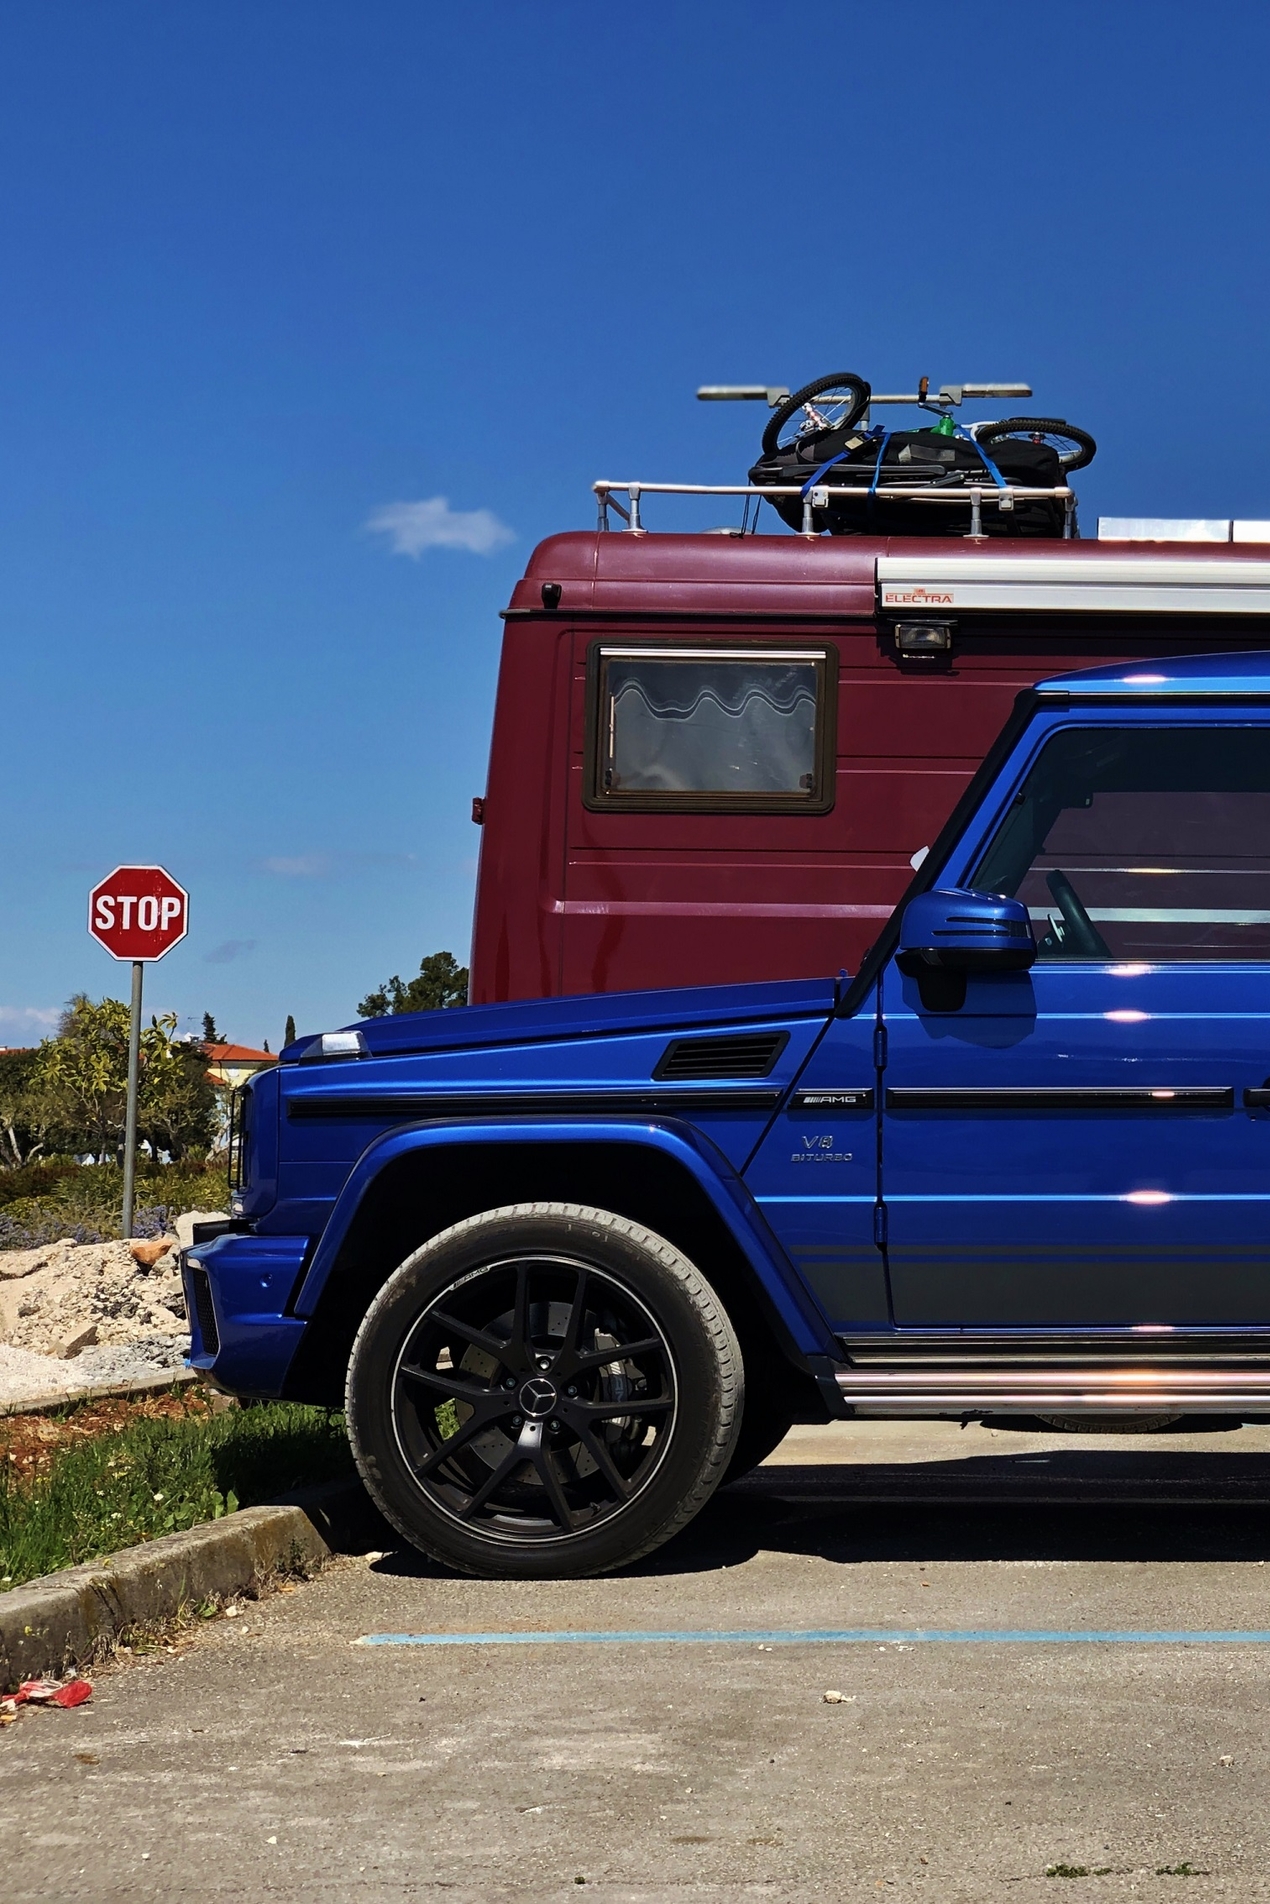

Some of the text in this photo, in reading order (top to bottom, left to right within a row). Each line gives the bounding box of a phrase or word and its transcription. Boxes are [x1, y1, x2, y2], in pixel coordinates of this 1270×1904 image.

[885, 594, 953, 604] ELECTRA
[95, 895, 181, 931] STOP
[802, 1135, 833, 1149] V8
[790, 1153, 853, 1161] BITURBO
